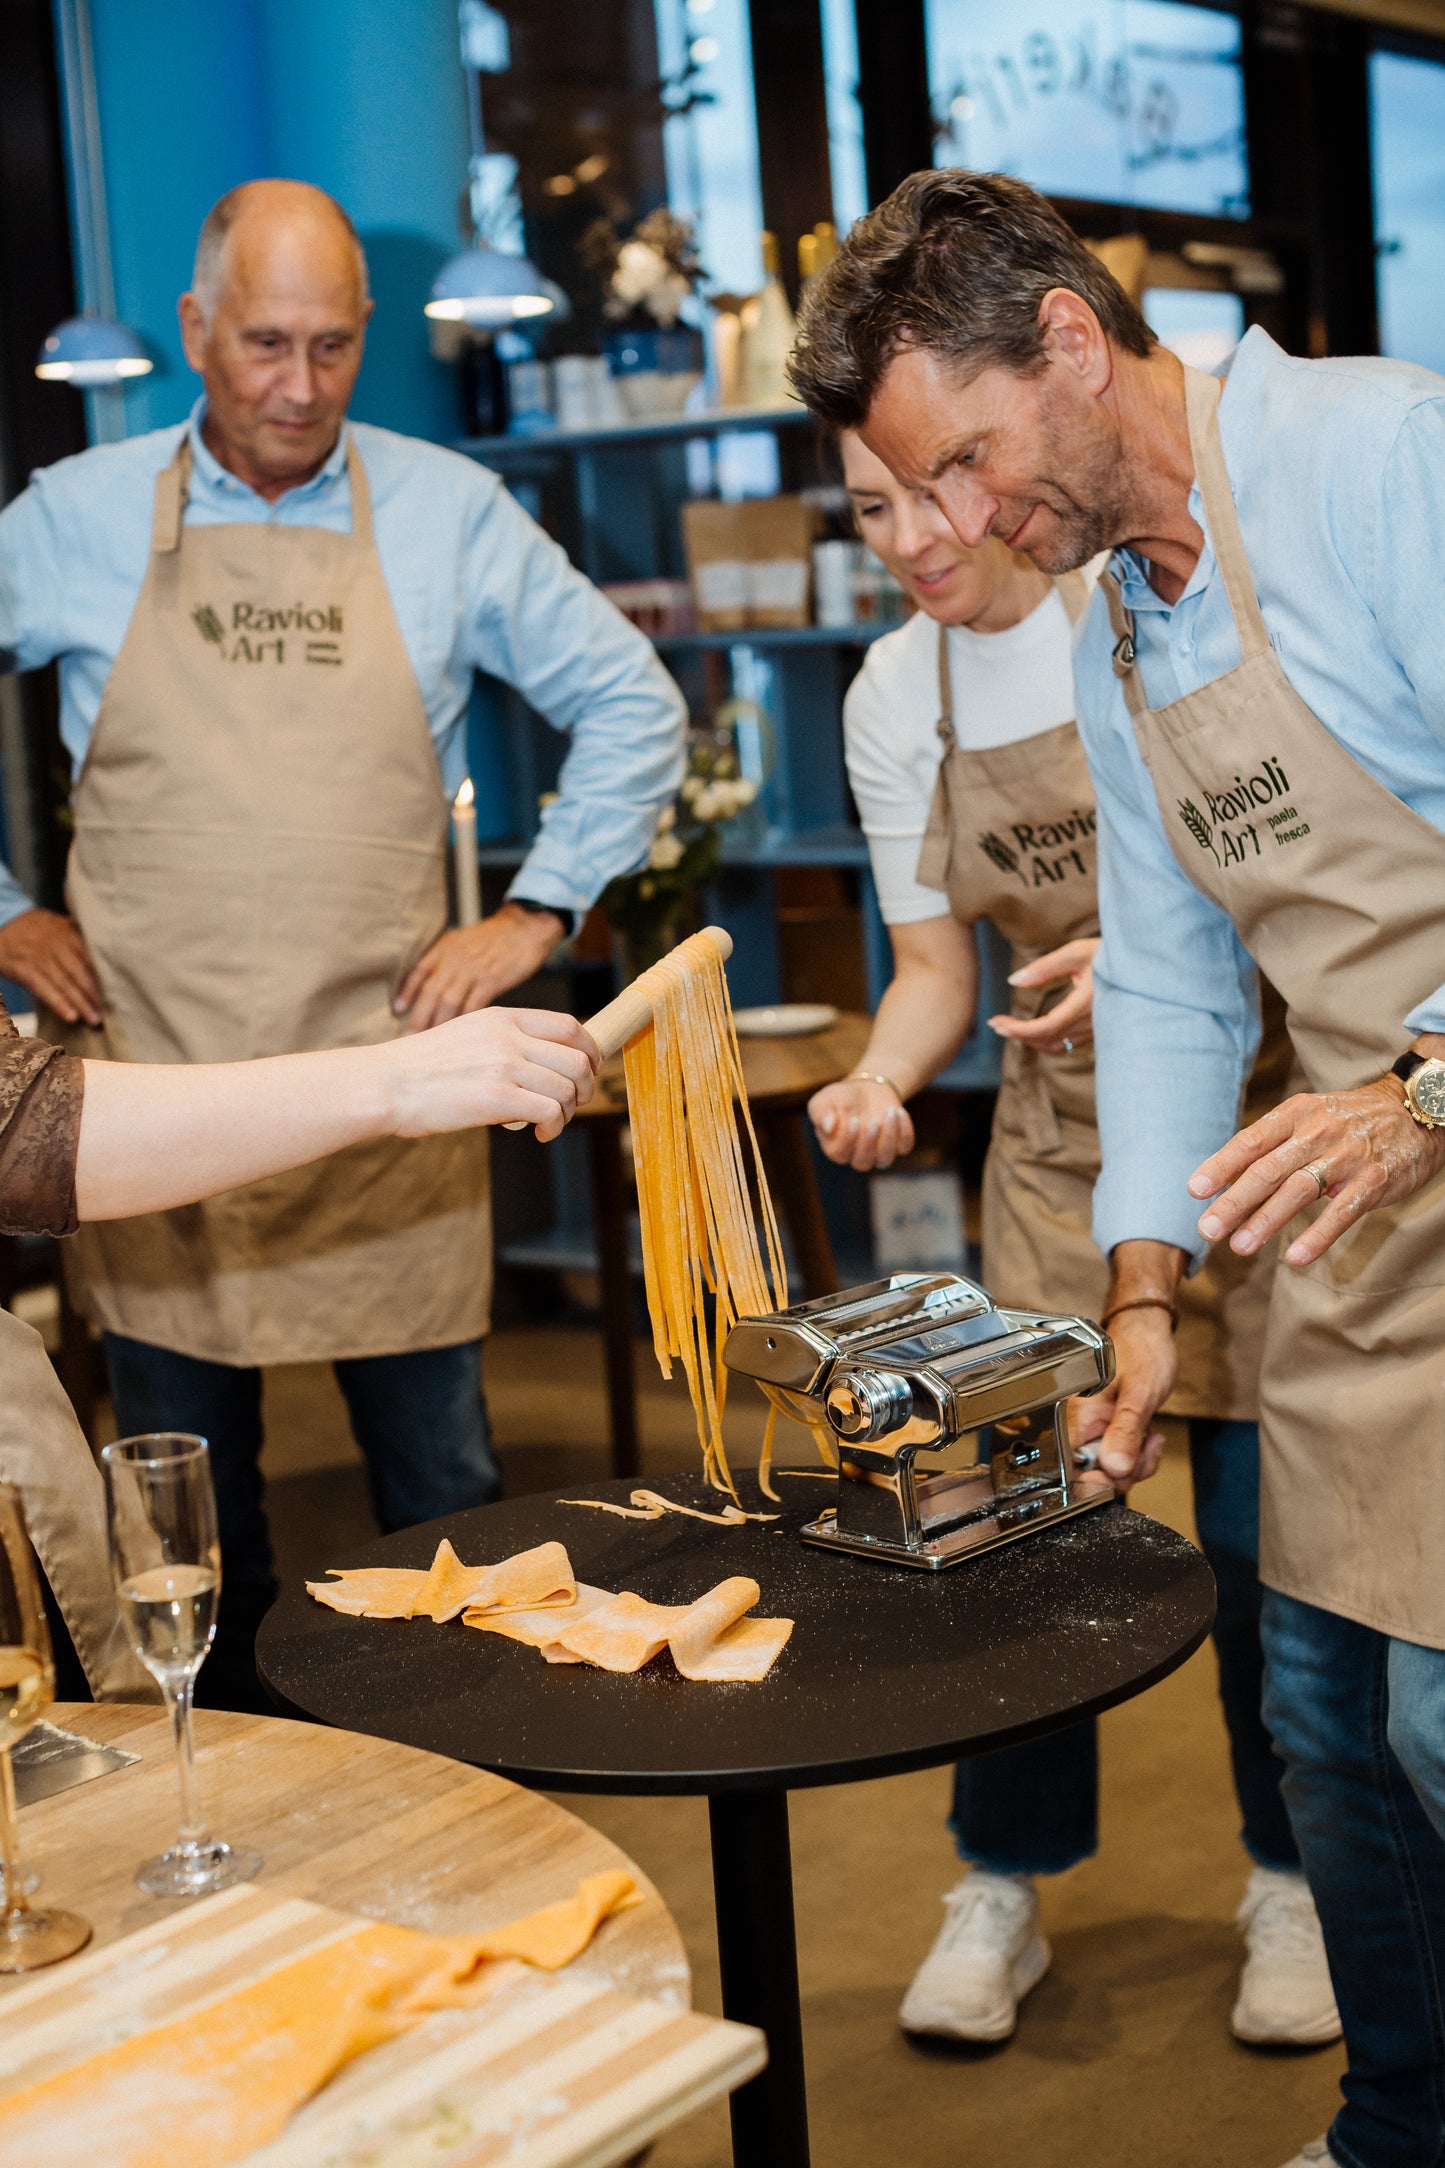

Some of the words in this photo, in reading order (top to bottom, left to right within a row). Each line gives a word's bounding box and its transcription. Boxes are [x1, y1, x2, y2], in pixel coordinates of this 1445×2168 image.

[233, 602, 342, 633] Ravioli
[231, 635, 284, 664] Art
[1202, 756, 1290, 825] Ravioli
[1266, 806, 1298, 830] pasta
[1221, 823, 1261, 867] Art
[1274, 823, 1311, 846] fresca
[1032, 848, 1086, 887] Art
